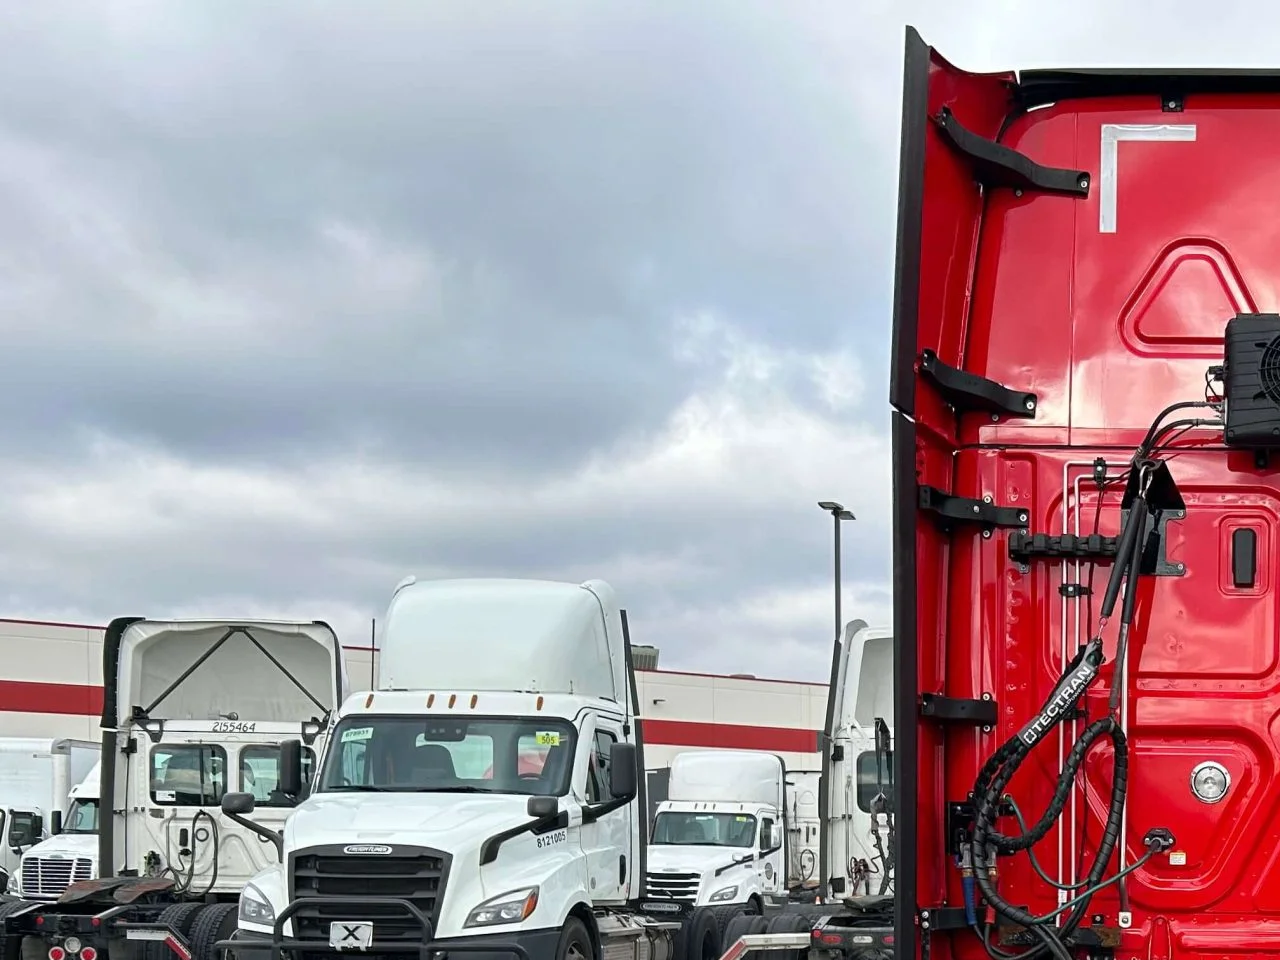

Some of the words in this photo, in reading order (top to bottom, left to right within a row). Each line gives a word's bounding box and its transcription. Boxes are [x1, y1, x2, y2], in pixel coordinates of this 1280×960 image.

[1032, 666, 1091, 732] TECTRAN
[212, 722, 256, 733] 2155464
[536, 831, 566, 848] 8121005
